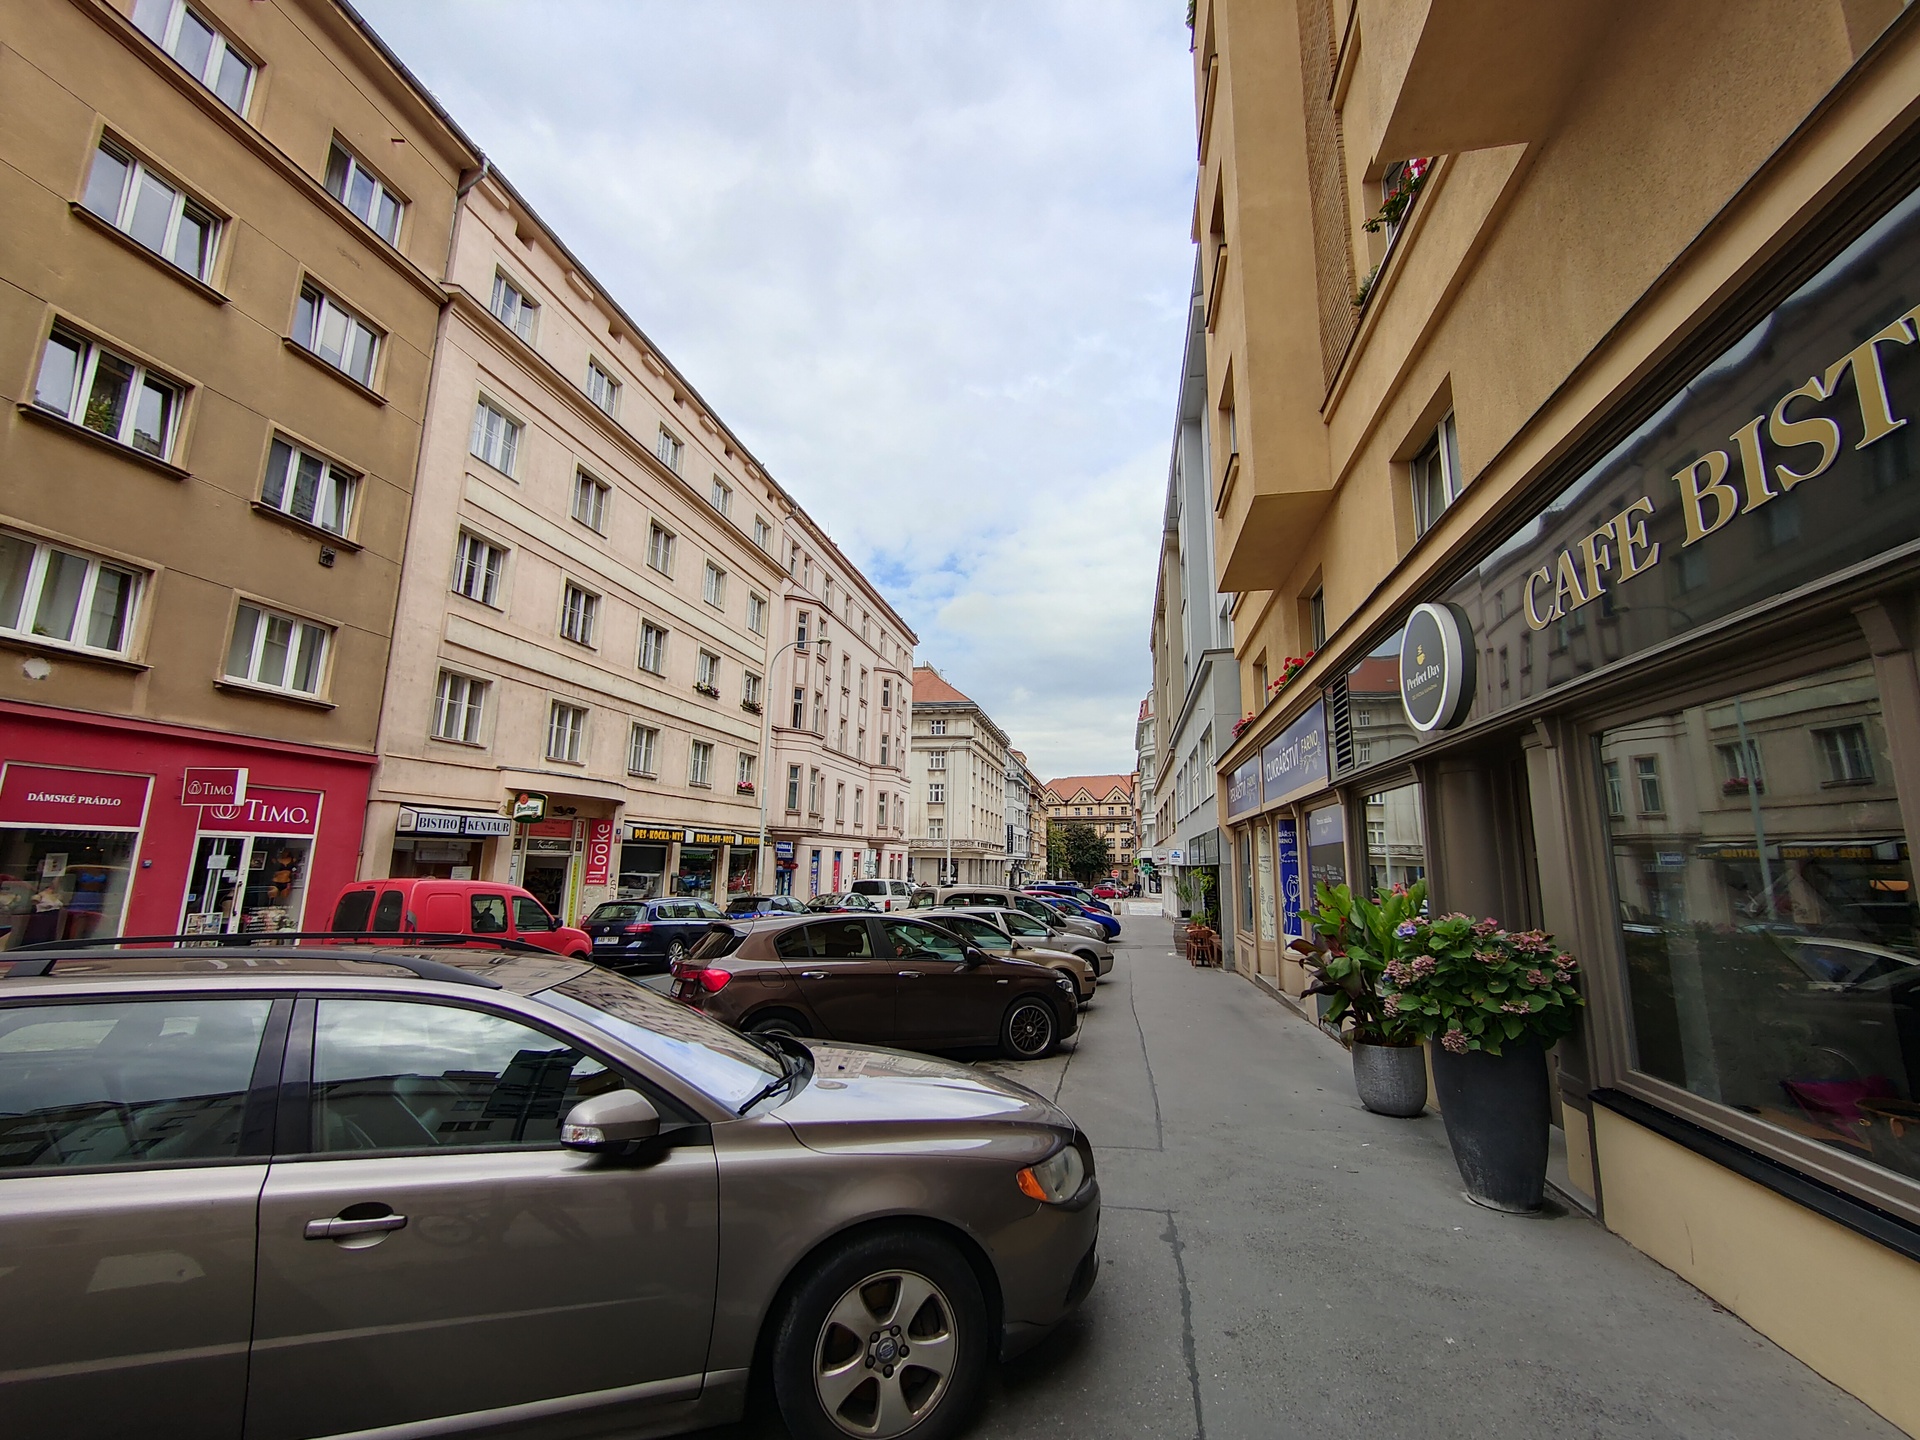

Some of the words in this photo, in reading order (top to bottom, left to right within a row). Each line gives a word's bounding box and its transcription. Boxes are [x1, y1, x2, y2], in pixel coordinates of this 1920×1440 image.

[1523, 496, 1661, 631] CAFE
[1671, 304, 1920, 548] BIST
[1406, 670, 1428, 692] Perfect
[1427, 664, 1440, 679] Day
[1266, 736, 1299, 783] CUKRÁŘSTVÍ
[27, 791, 77, 804] DÁMSKÉ
[77, 795, 121, 806] PRÁDLO
[419, 817, 458, 829] BISTRO
[467, 820, 509, 833] KENTAUR
